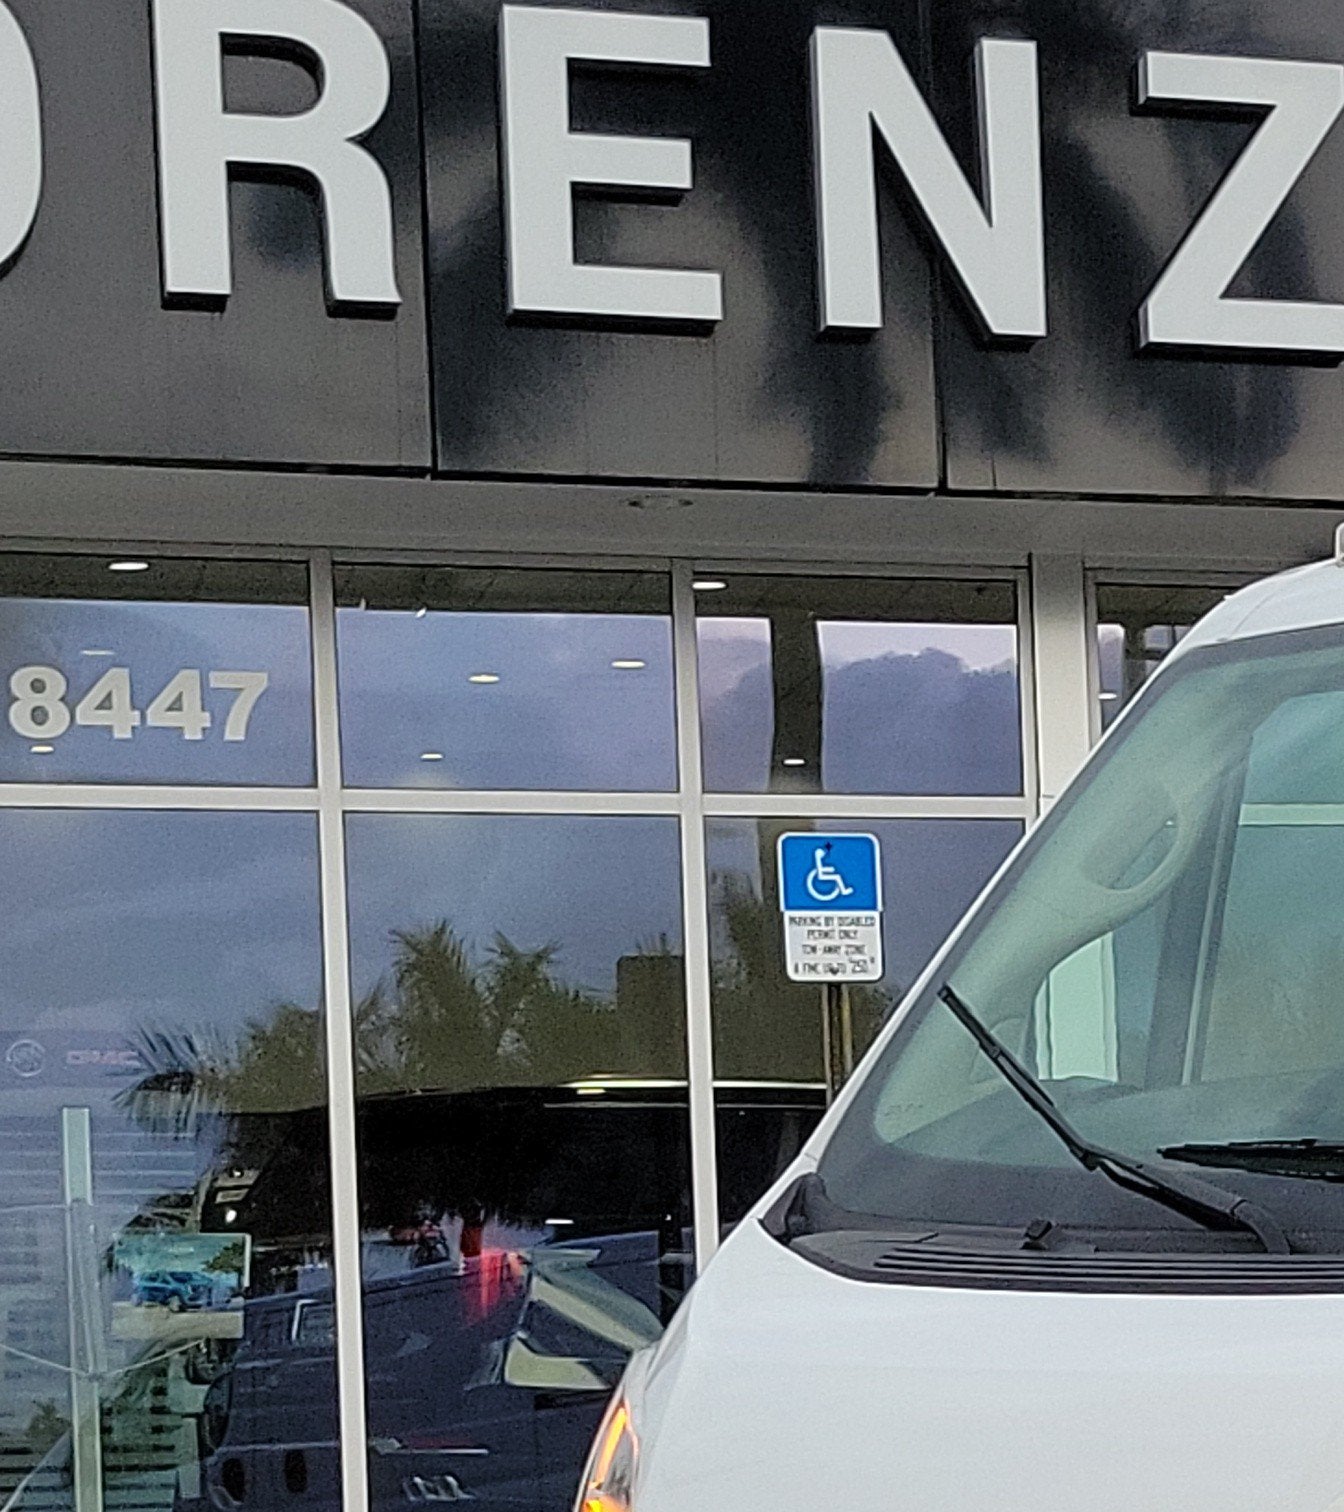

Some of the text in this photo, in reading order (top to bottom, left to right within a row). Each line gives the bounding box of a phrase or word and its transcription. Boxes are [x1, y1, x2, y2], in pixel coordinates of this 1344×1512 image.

[8, 664, 269, 742] 8447
[788, 916, 876, 927] PARKING BY DISABLED
[808, 929, 860, 940] PERMIT ONLY
